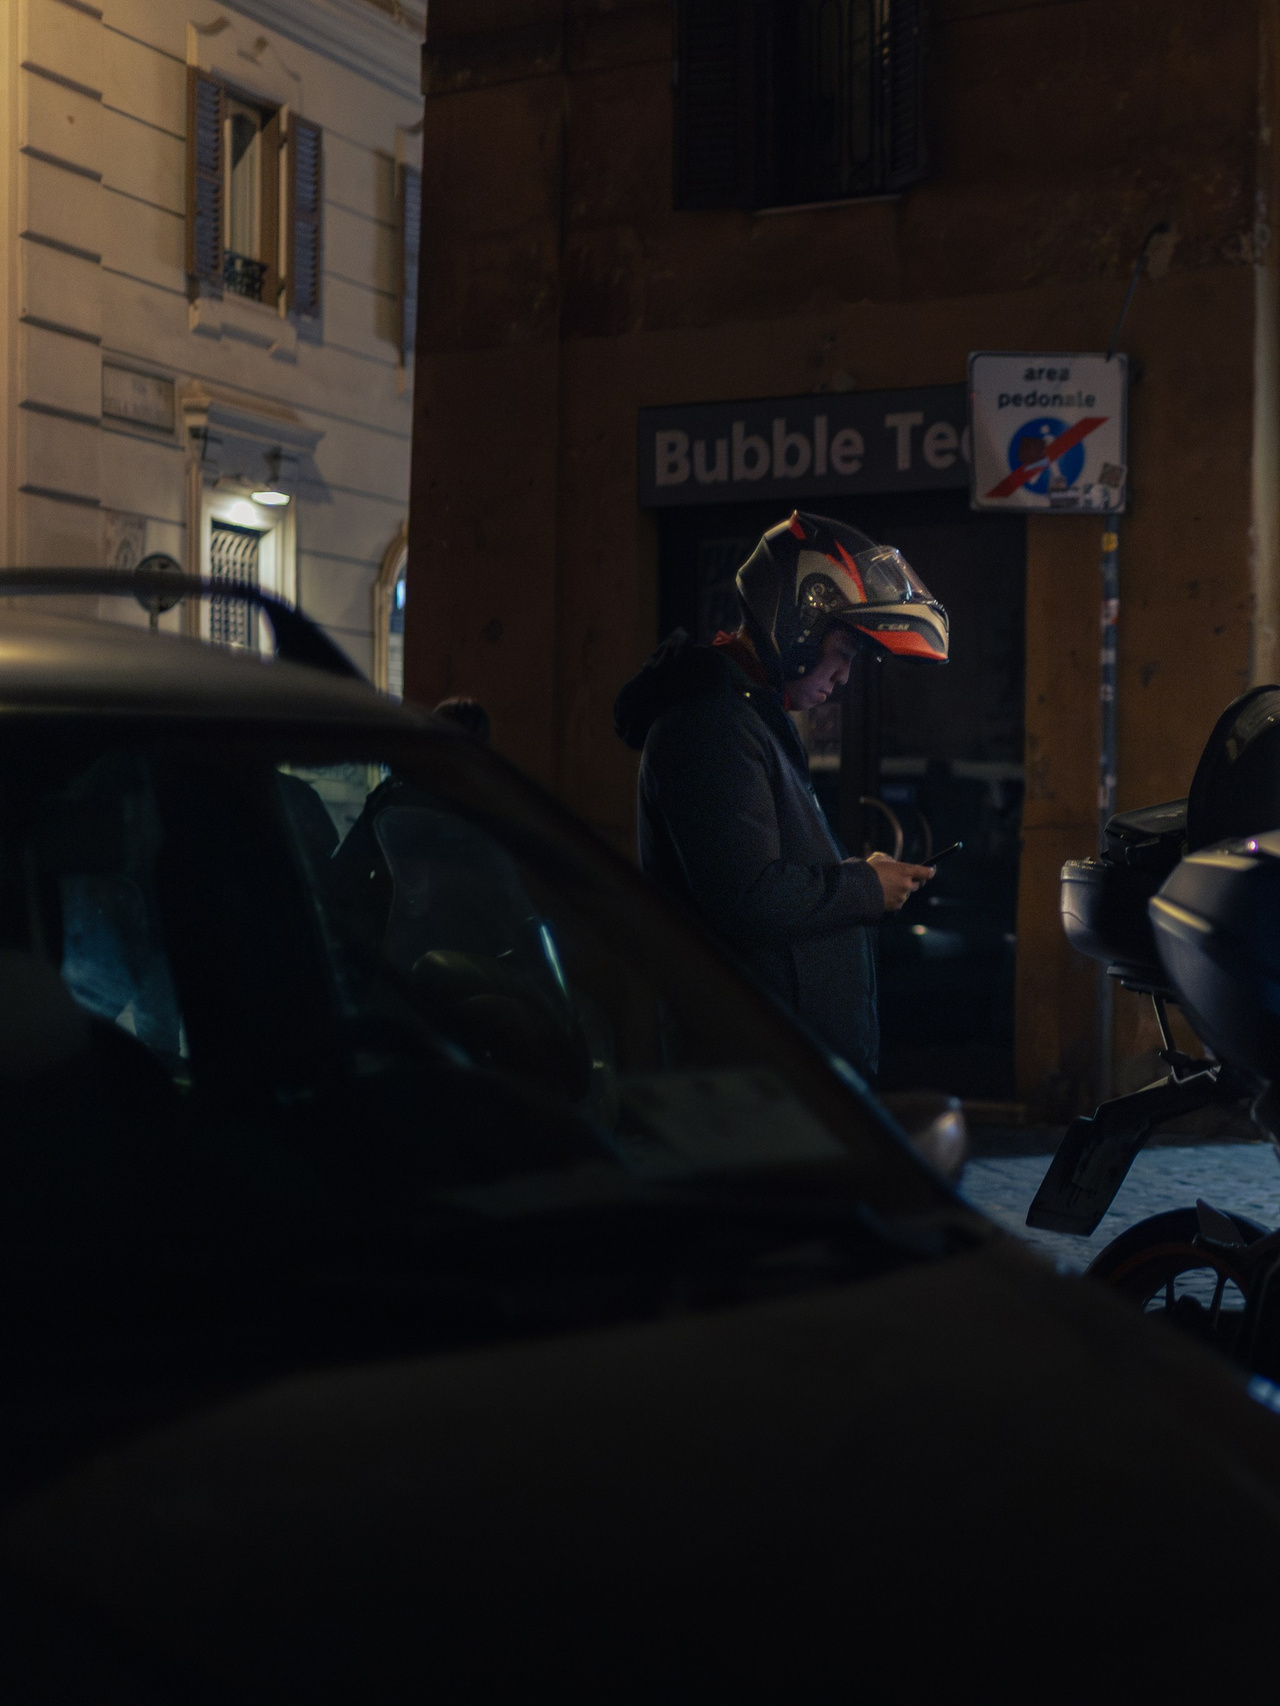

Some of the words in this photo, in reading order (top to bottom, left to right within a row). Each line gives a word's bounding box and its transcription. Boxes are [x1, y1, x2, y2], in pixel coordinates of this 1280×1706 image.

[1024, 367, 1070, 382] area
[998, 390, 1097, 408] pedonale
[655, 414, 865, 487] Bubble
[884, 411, 971, 472] Te
